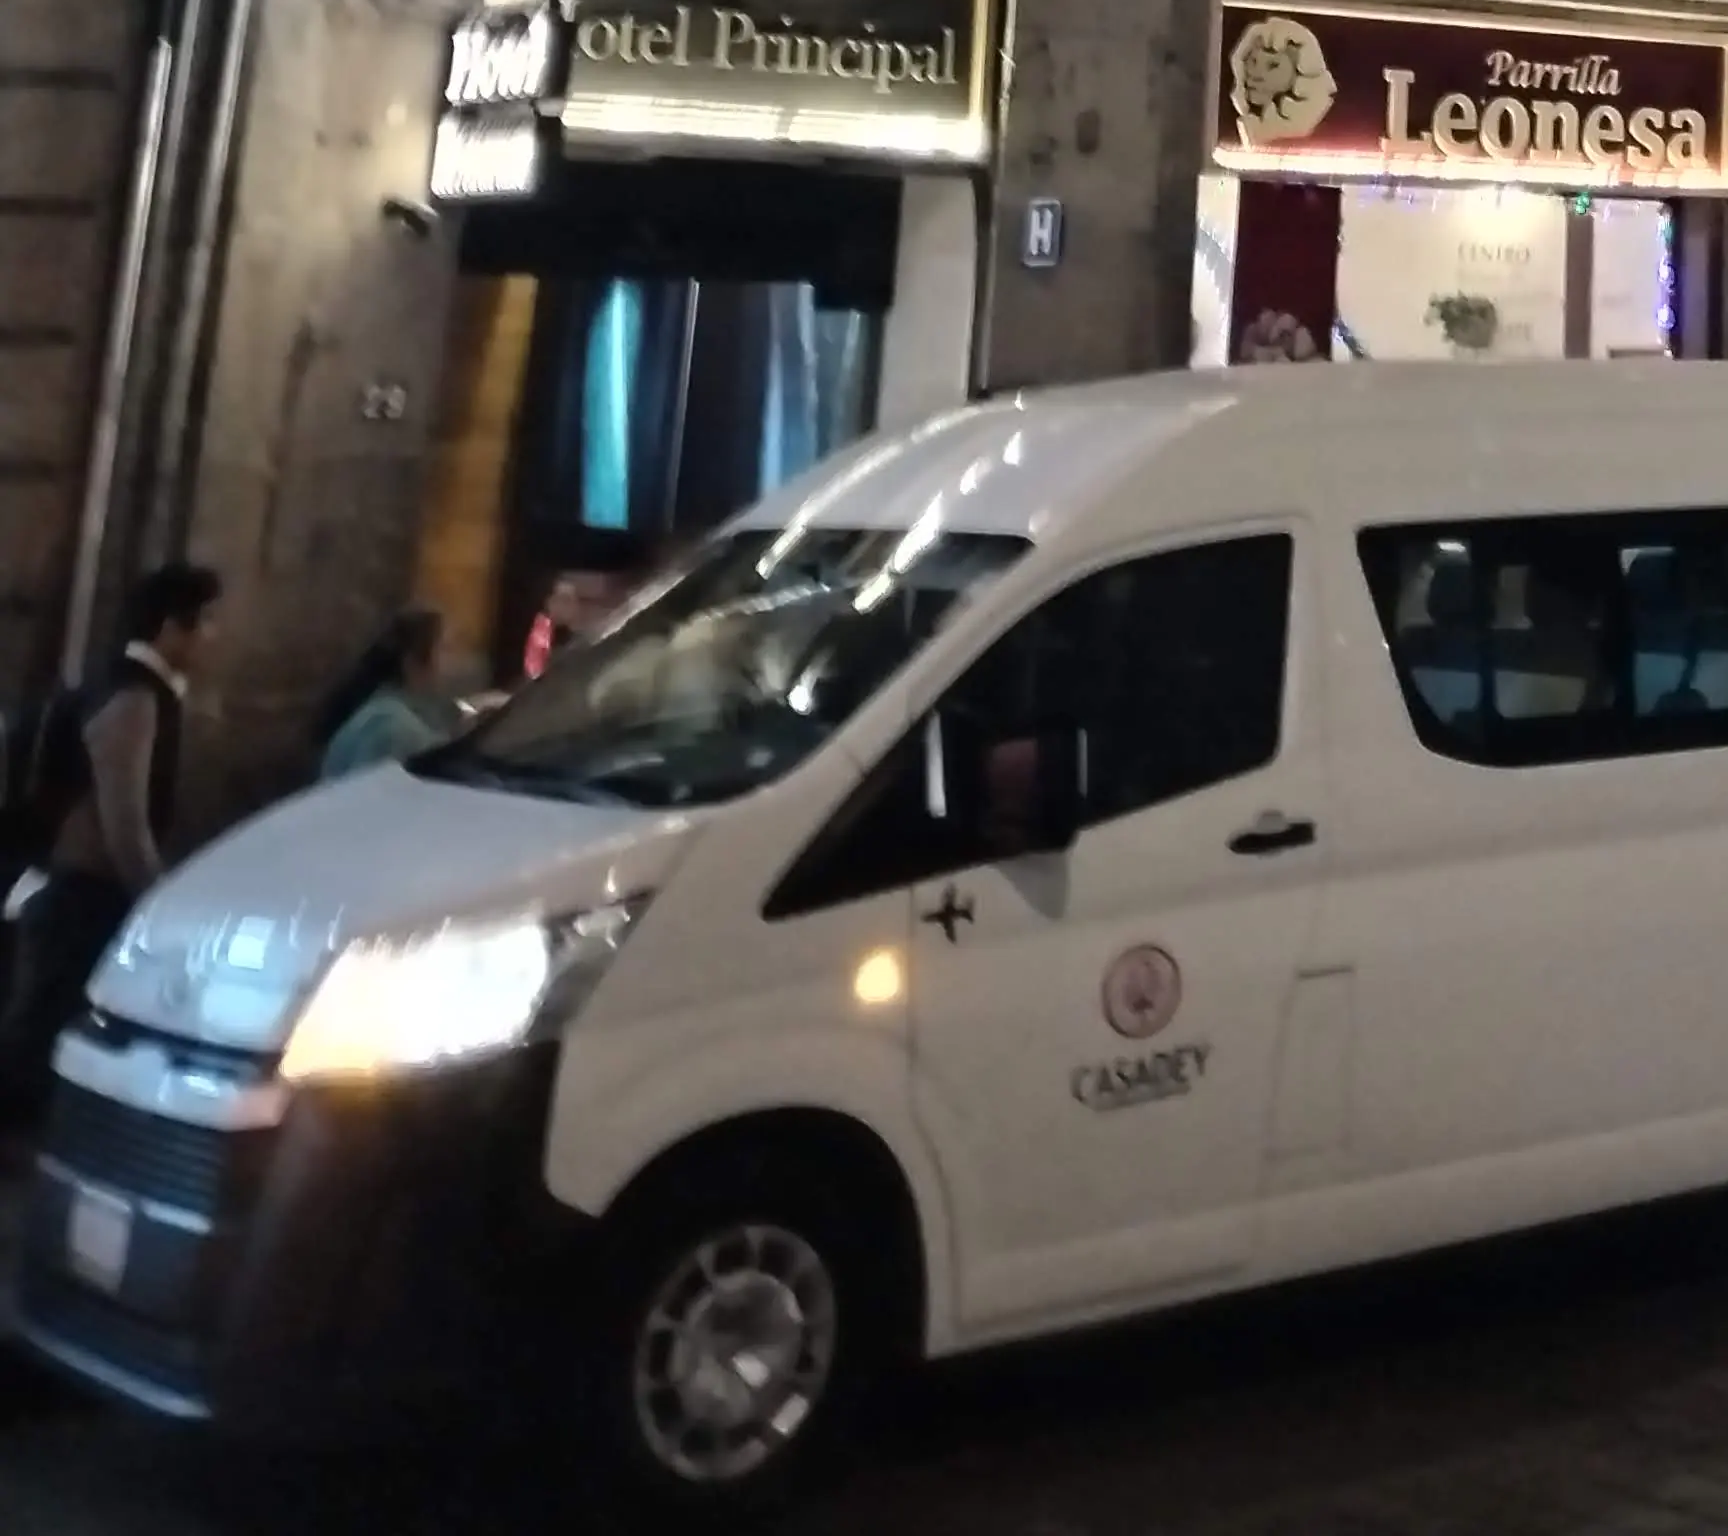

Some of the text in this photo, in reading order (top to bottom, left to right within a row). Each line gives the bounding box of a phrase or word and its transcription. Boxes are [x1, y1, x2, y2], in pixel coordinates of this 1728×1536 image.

[712, 7, 958, 94] Principal
[1487, 49, 1622, 97] Parrilla
[1381, 66, 1709, 170] Leonesa
